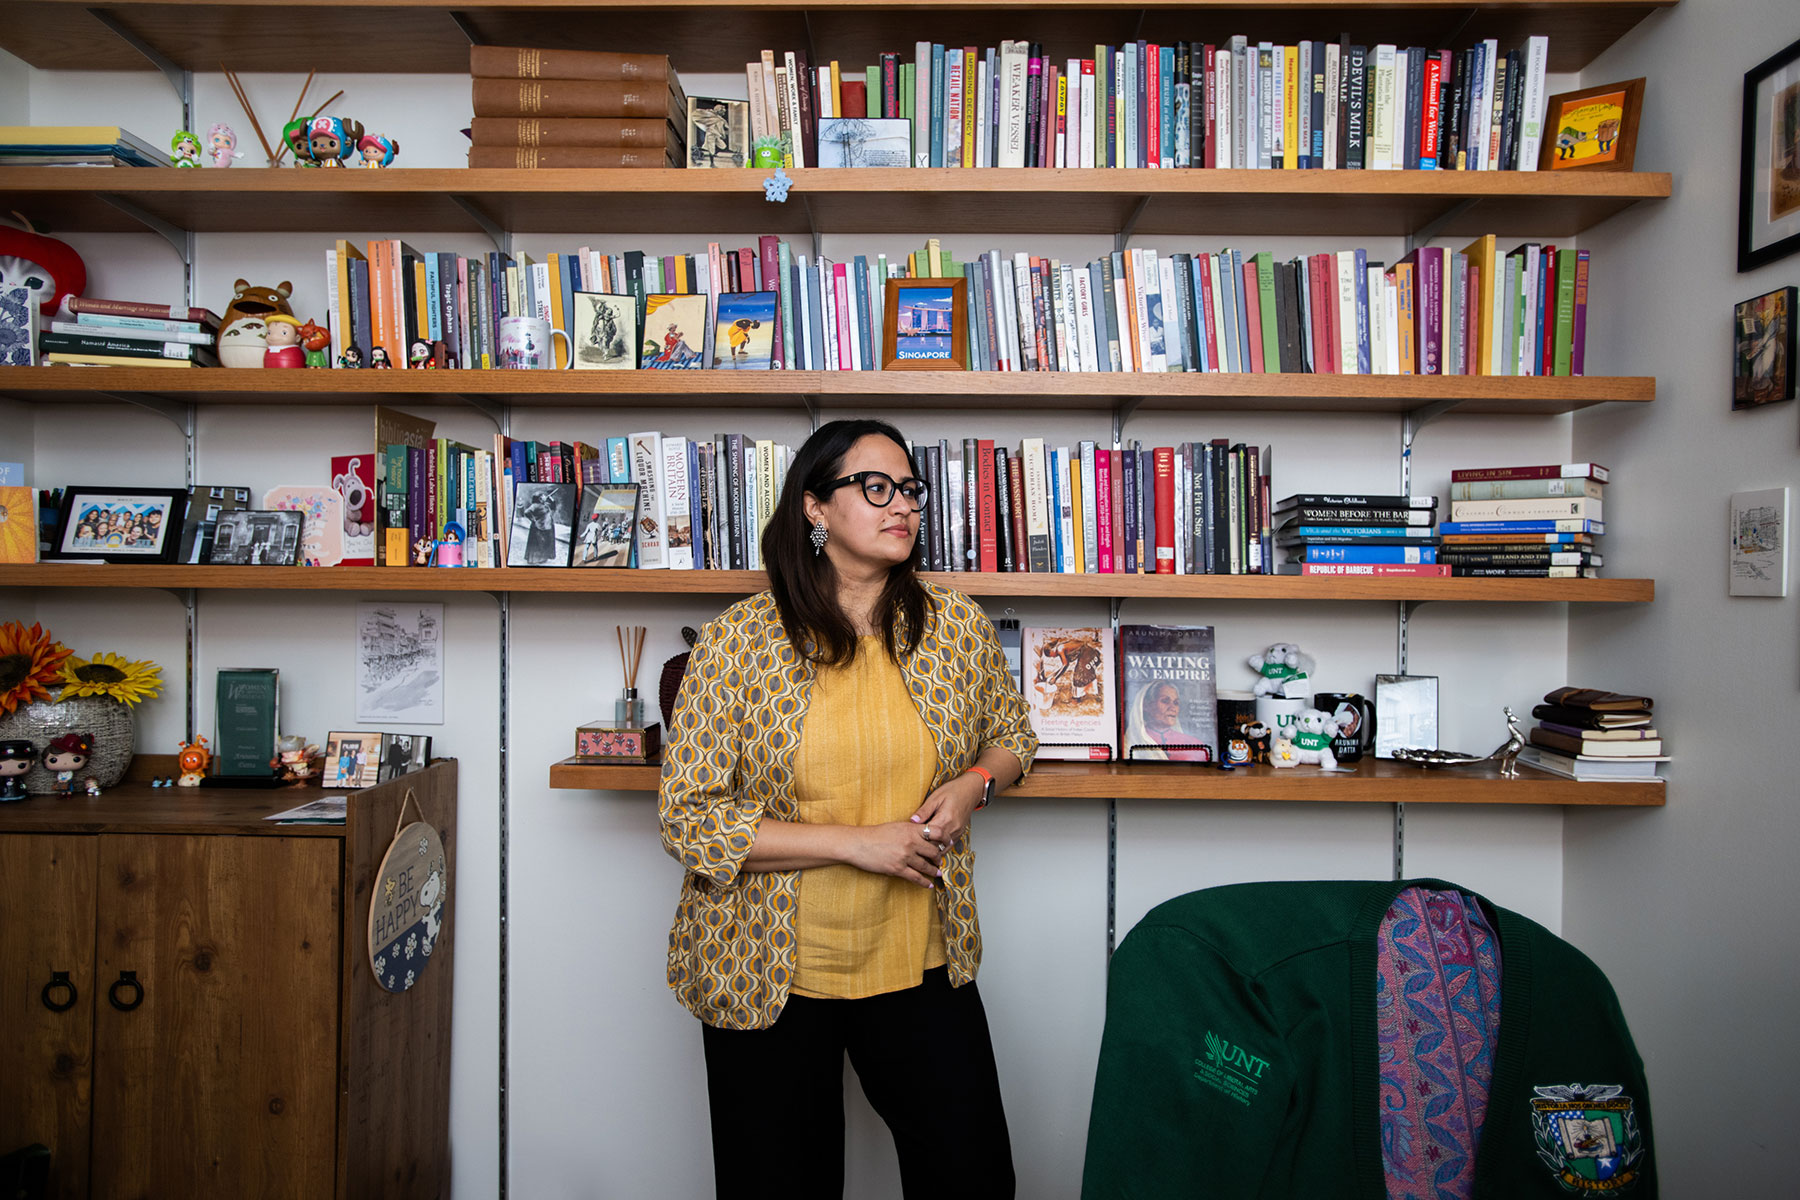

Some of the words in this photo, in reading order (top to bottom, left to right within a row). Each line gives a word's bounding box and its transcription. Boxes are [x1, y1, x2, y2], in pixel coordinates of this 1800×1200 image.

[950, 65, 960, 89] RETAIL
[1475, 47, 1483, 83] APPROACHES
[1012, 63, 1021, 111] WEAKER
[1314, 74, 1324, 93] BLUE
[1350, 56, 1362, 109] DEVIL'S
[1429, 72, 1438, 105] Manual
[1495, 68, 1505, 102] BANDITS
[950, 93, 960, 119] NATION
[1264, 106, 1271, 114] OF
[1303, 96, 1308, 104] OF
[1429, 106, 1438, 119] for
[1530, 97, 1538, 119] READER
[1349, 112, 1360, 148] MILK
[1451, 103, 1460, 132] Banquet
[1011, 115, 1020, 154] VESSEL
[1313, 130, 1323, 157] MORAN
[1427, 121, 1436, 152] Writers
[1052, 268, 1061, 301] BANDITS
[1079, 277, 1087, 300] FACTORY
[1137, 286, 1145, 318] Victorious
[899, 351, 949, 359] SINGAPORE
[636, 452, 645, 477] LIQUOR
[982, 447, 992, 480] Bodies
[1011, 460, 1019, 477] THE
[1457, 470, 1486, 478] LIVING
[645, 461, 654, 493] SMASHING
[667, 455, 677, 499] BRITAIN
[676, 452, 685, 501] MODERN
[733, 478, 739, 487] OF
[983, 482, 992, 492] in
[1193, 473, 1202, 489] Not
[640, 479, 651, 512] MACHINE
[1012, 478, 1022, 519] PASSPORT
[1194, 491, 1202, 504] Fit
[983, 494, 992, 532] Contact
[1194, 506, 1201, 515] to
[1304, 509, 1338, 518] WOMEN
[1339, 509, 1371, 518] BEFORE
[1373, 510, 1390, 518] THE
[1393, 510, 1409, 518] BAR
[1193, 517, 1203, 538] Stay
[1309, 565, 1336, 574] REPUBLIC
[1337, 566, 1344, 574] OF
[1346, 566, 1374, 574] BARBECUE
[1127, 655, 1210, 669] WAITING
[1128, 669, 1149, 681] ON
[1152, 669, 1211, 681] EMPIRE
[1041, 718, 1067, 727] Fleeting
[1070, 719, 1101, 728] Agencies
[1301, 738, 1319, 746] UNT
[398, 865, 415, 898] BE
[375, 890, 420, 946] HAPPY
[1221, 1040, 1270, 1078] UNT
